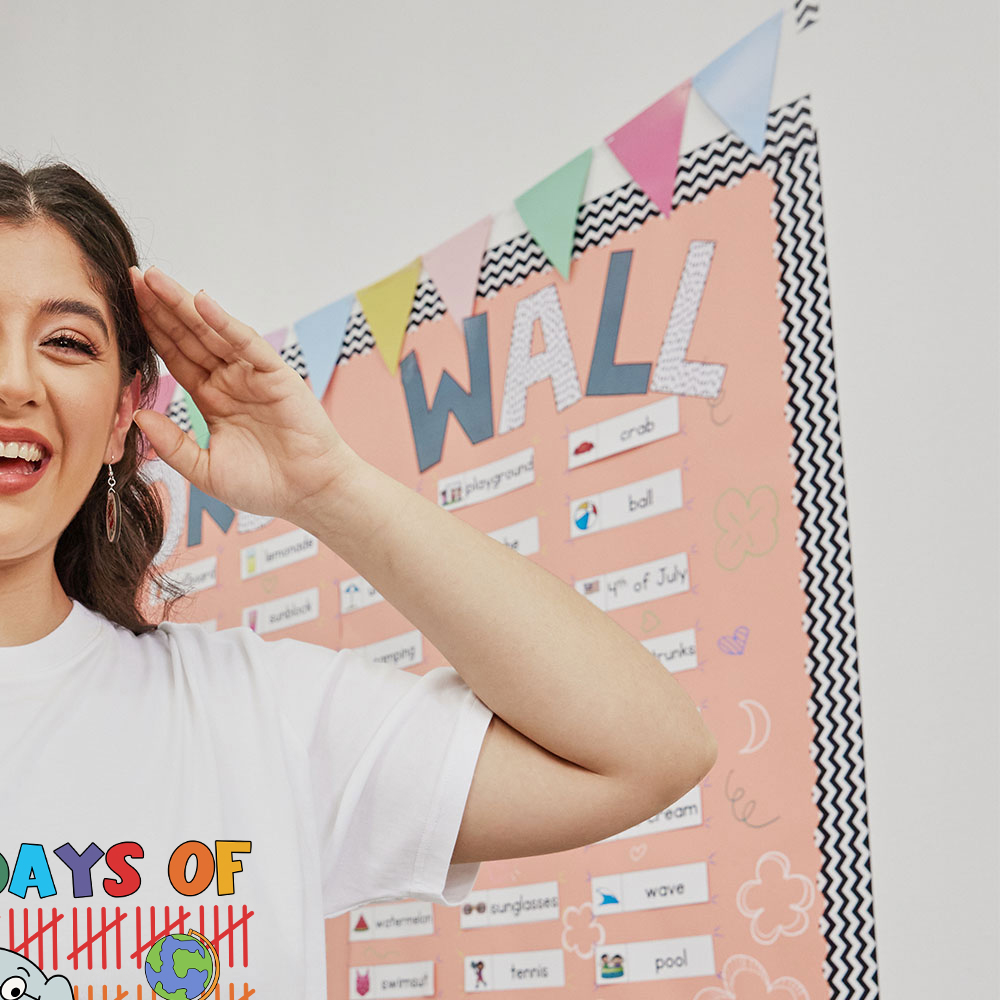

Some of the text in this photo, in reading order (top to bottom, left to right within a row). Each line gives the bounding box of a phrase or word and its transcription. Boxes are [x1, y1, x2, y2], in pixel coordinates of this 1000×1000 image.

[398, 239, 728, 474] WALL
[619, 417, 655, 442] crab
[465, 456, 535, 497] playground
[627, 488, 655, 512] ball
[265, 537, 314, 562] lemonade
[633, 572, 651, 592] of
[656, 564, 687, 586] July
[268, 601, 313, 625] sunblock
[167, 839, 253, 897] OF
[644, 881, 685, 899] wave
[489, 894, 559, 917] sunglasses
[510, 963, 549, 981] tennis
[654, 948, 688, 973] pool
